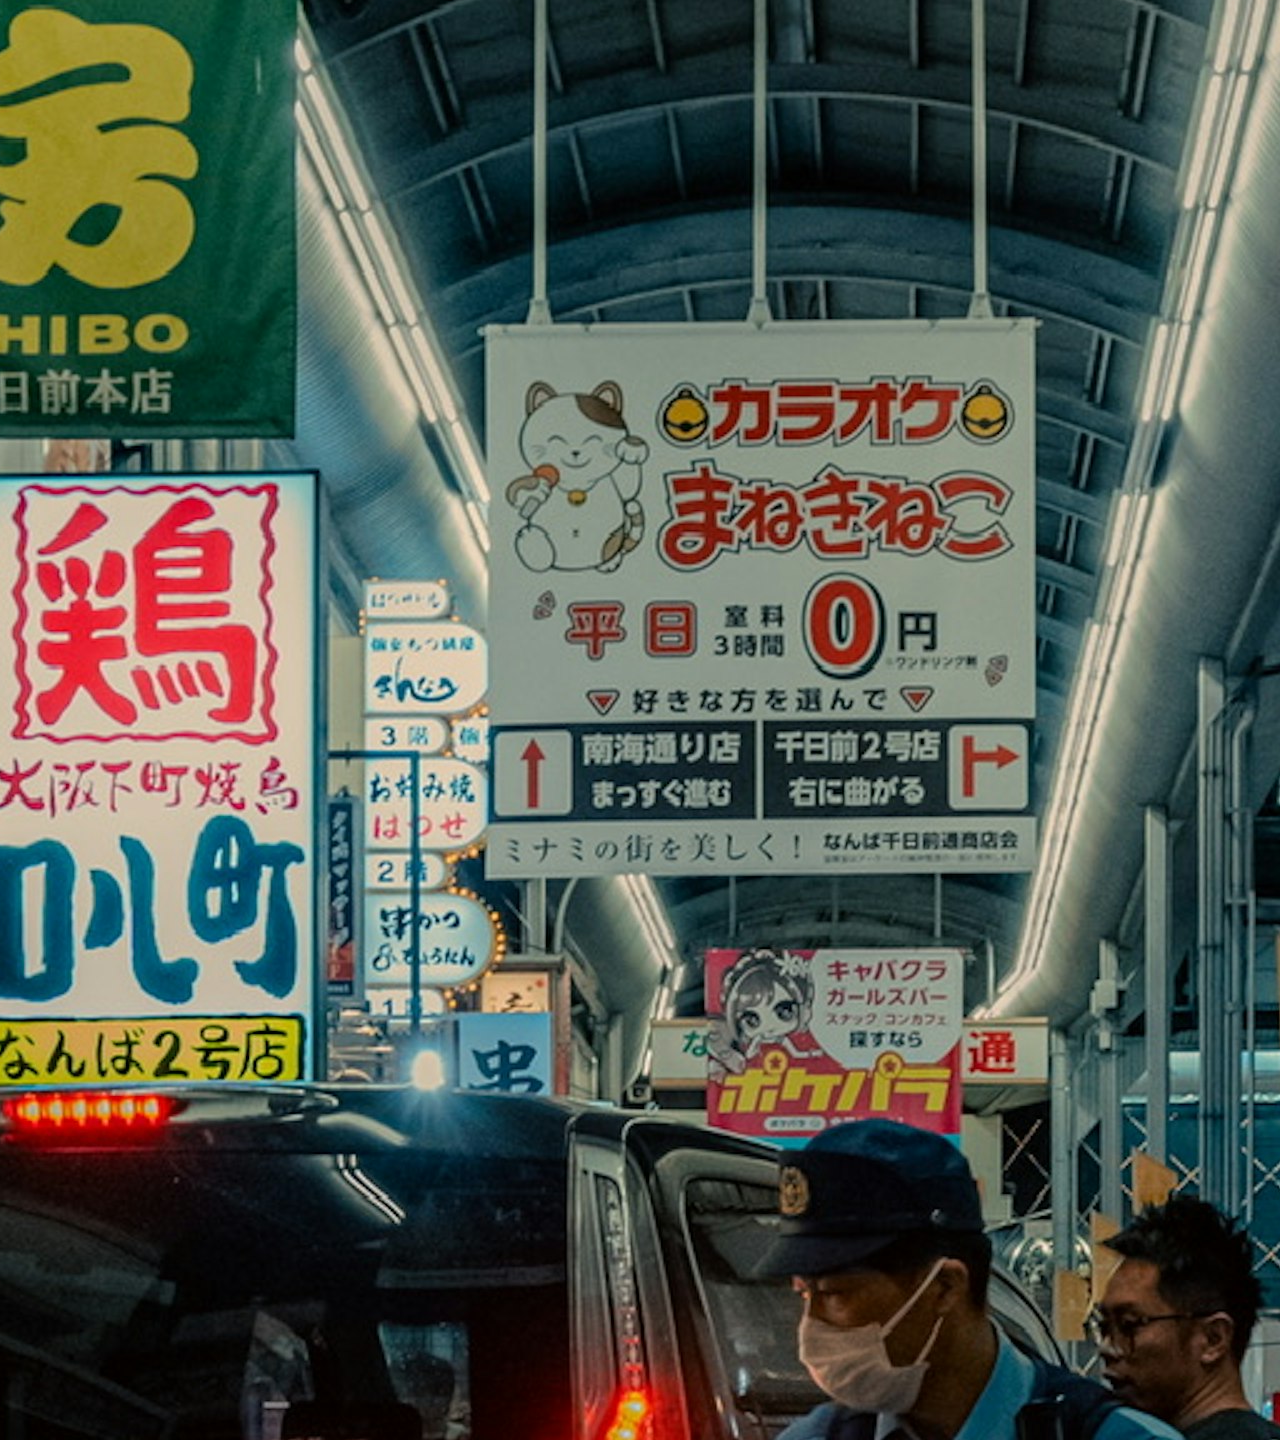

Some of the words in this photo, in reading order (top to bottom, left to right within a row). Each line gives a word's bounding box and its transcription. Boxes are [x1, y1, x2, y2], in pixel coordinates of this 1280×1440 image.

[710, 376, 962, 444] カラオケ
[660, 461, 1013, 567] まねきねこ
[36, 498, 258, 726] 鶏
[724, 604, 785, 629] 室料
[566, 602, 698, 660] 平日
[714, 634, 785, 658] 3時間
[897, 611, 938, 652] 円
[632, 687, 888, 715] 好きな方を選んで
[582, 732, 741, 765] 南海通り店
[774, 730, 942, 763] 千日前2号店
[591, 778, 732, 809] まっすぐ進む
[788, 775, 926, 806] 右に曲がる
[823, 830, 1019, 851] なんば千日前通商店会
[826, 960, 947, 979] キャバクラ
[826, 988, 948, 1006] ガールズバー
[826, 1013, 877, 1026] スナック
[849, 1031, 923, 1048] 探すなら
[968, 1031, 1017, 1074] 通
[717, 1052, 953, 1114] ポケパラ
